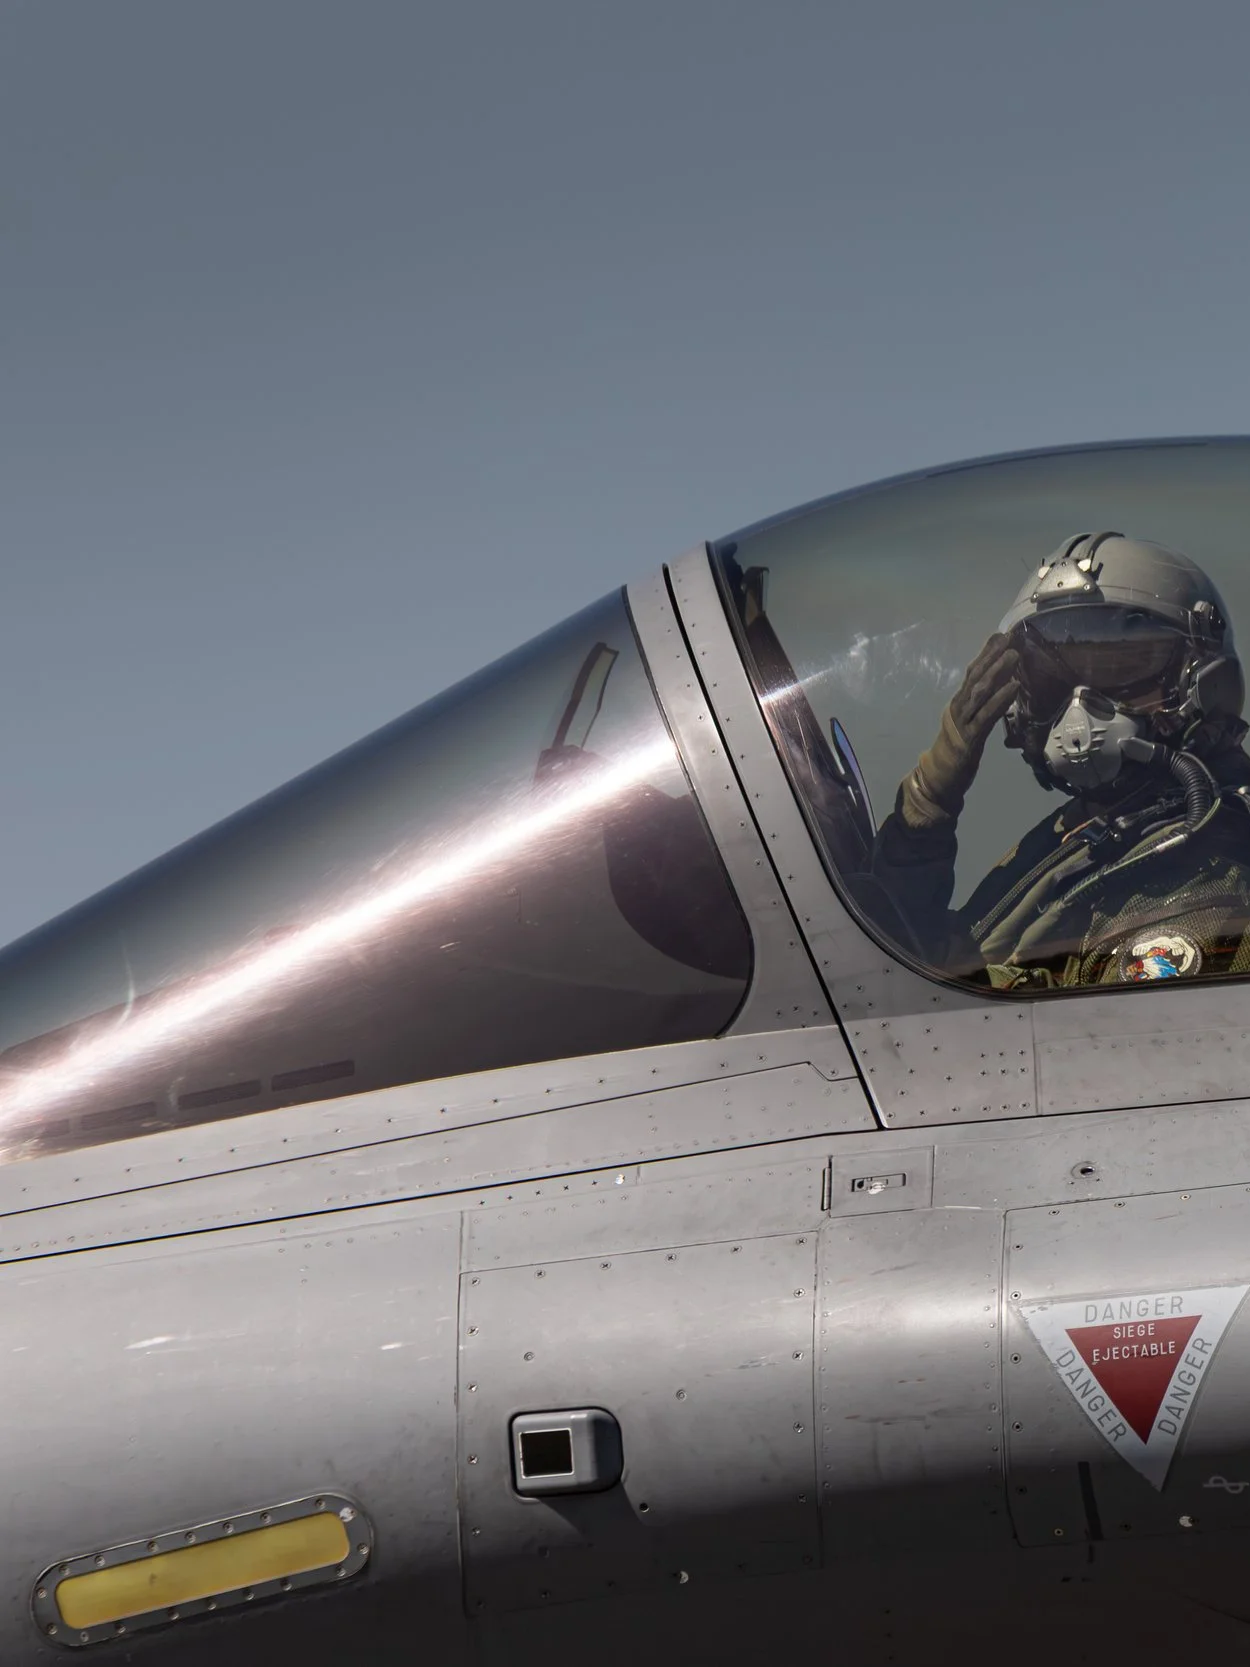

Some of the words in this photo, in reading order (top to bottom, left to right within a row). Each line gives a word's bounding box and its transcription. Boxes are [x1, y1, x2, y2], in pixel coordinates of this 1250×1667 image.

[1084, 1295, 1184, 1323] DANGER
[1113, 1323, 1155, 1339] SIEGE
[1093, 1341, 1176, 1362] EJECTABLE
[1056, 1349, 1127, 1442] DANGER
[1157, 1337, 1212, 1436] DANGER
